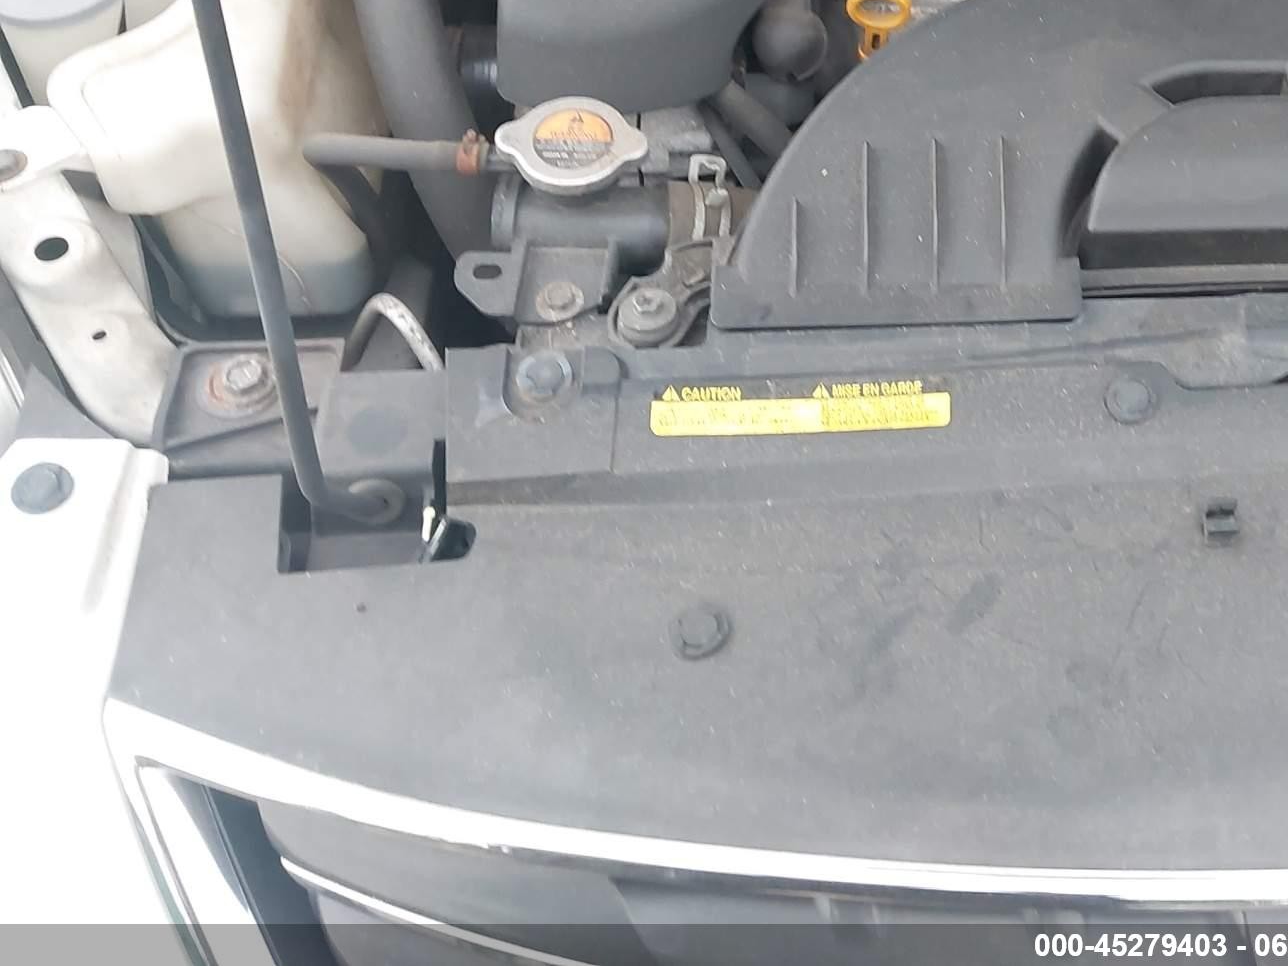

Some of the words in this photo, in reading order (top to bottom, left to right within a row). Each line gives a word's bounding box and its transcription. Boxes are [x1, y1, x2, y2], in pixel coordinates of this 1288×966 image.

[681, 386, 742, 401] CAUTION
[862, 382, 880, 397] EN
[881, 380, 923, 396] GARDE
